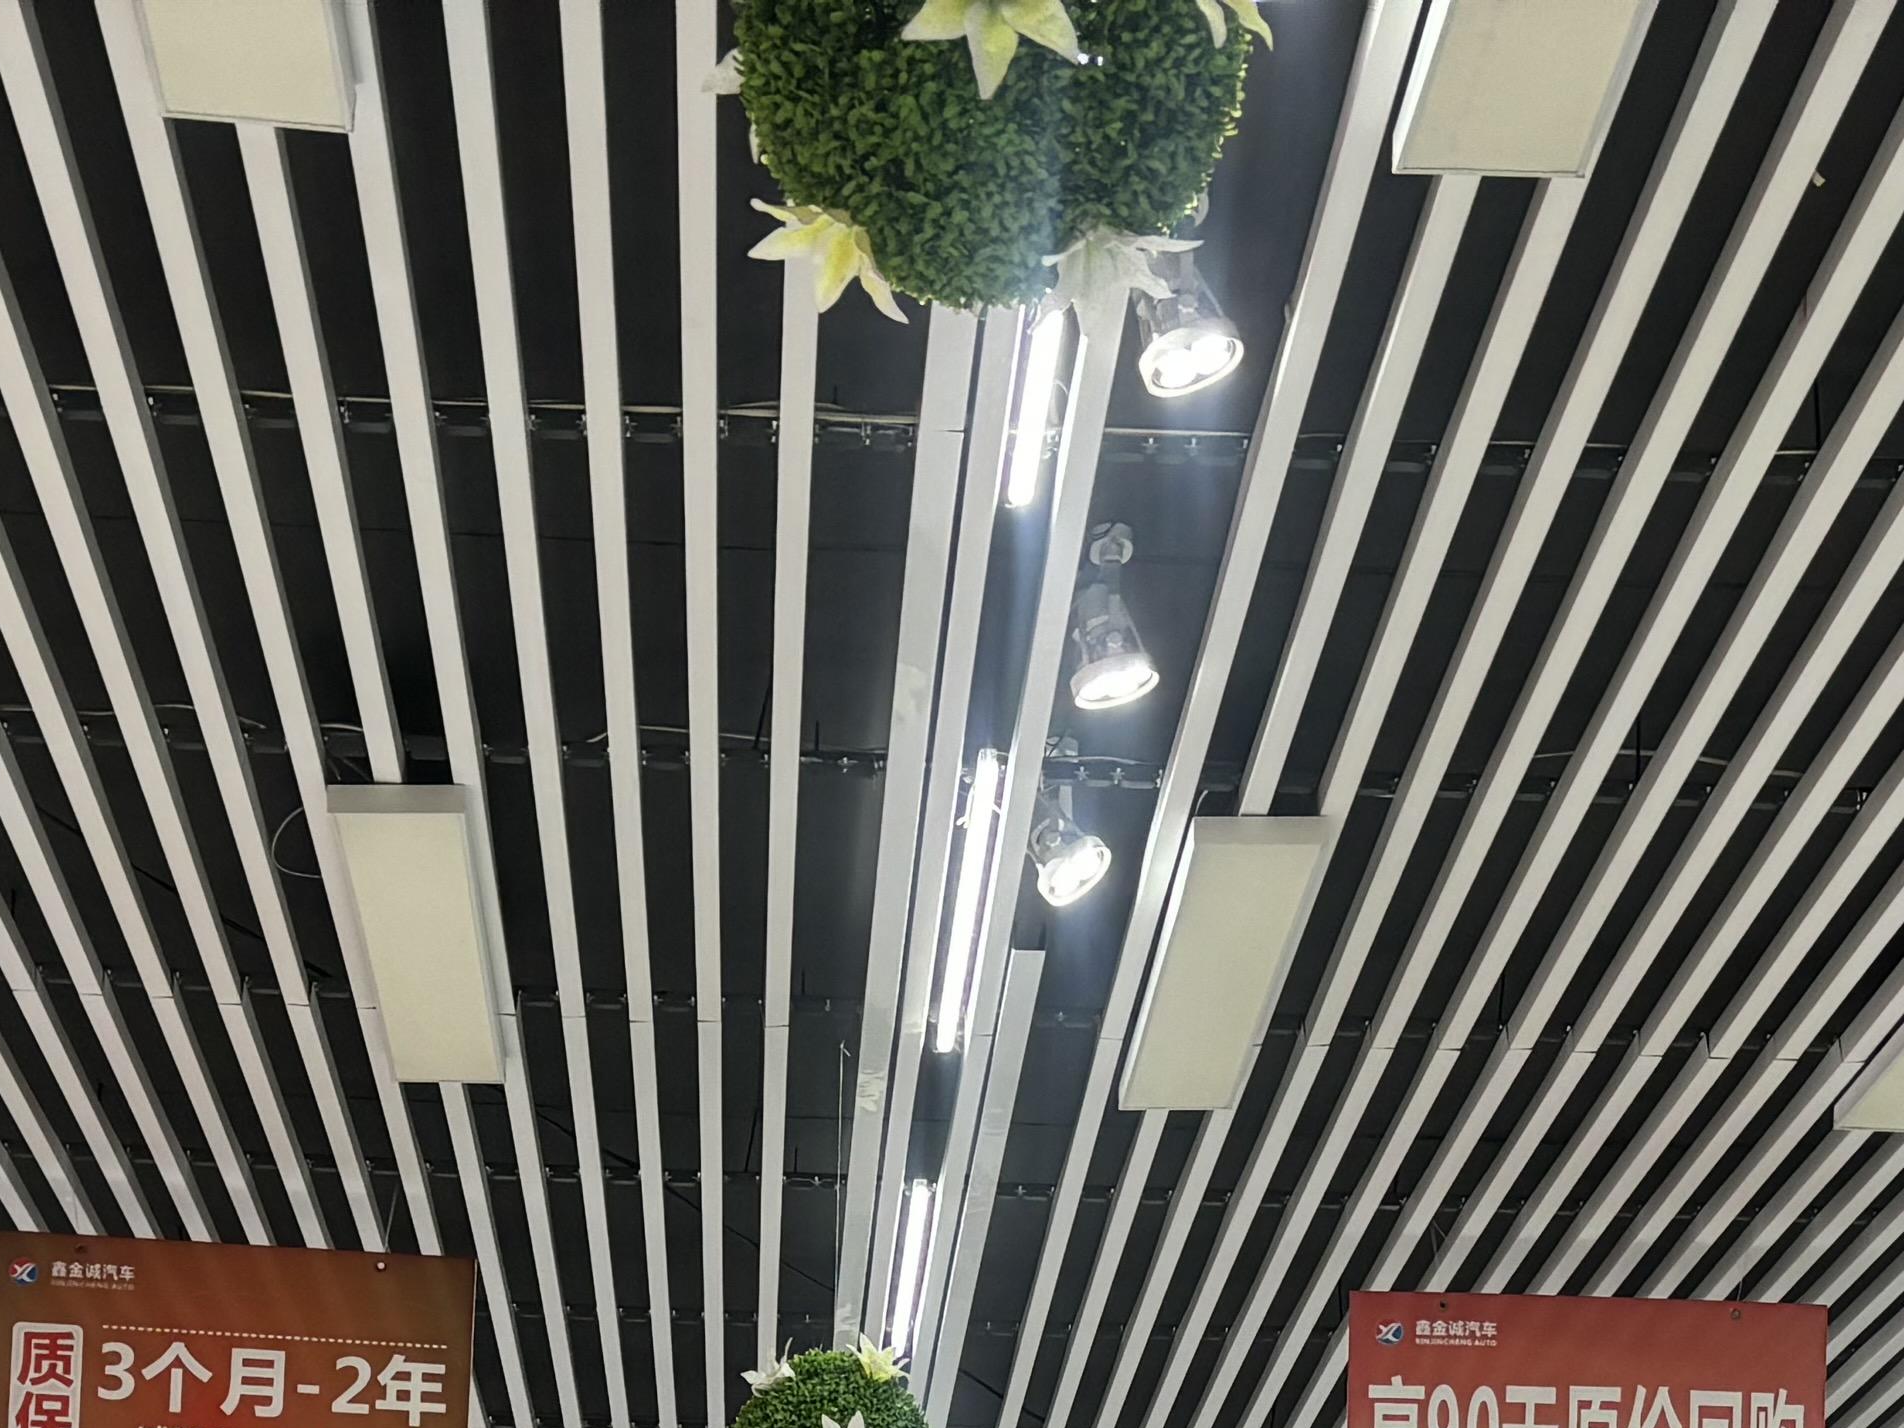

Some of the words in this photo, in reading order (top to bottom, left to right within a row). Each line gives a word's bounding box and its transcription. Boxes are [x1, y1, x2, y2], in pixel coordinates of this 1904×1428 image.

[50, 1260, 136, 1282] 鑫金诚汽车
[1415, 1319, 1498, 1338] 鑫金诚汽车
[96, 1340, 448, 1428] 3个月-2年
